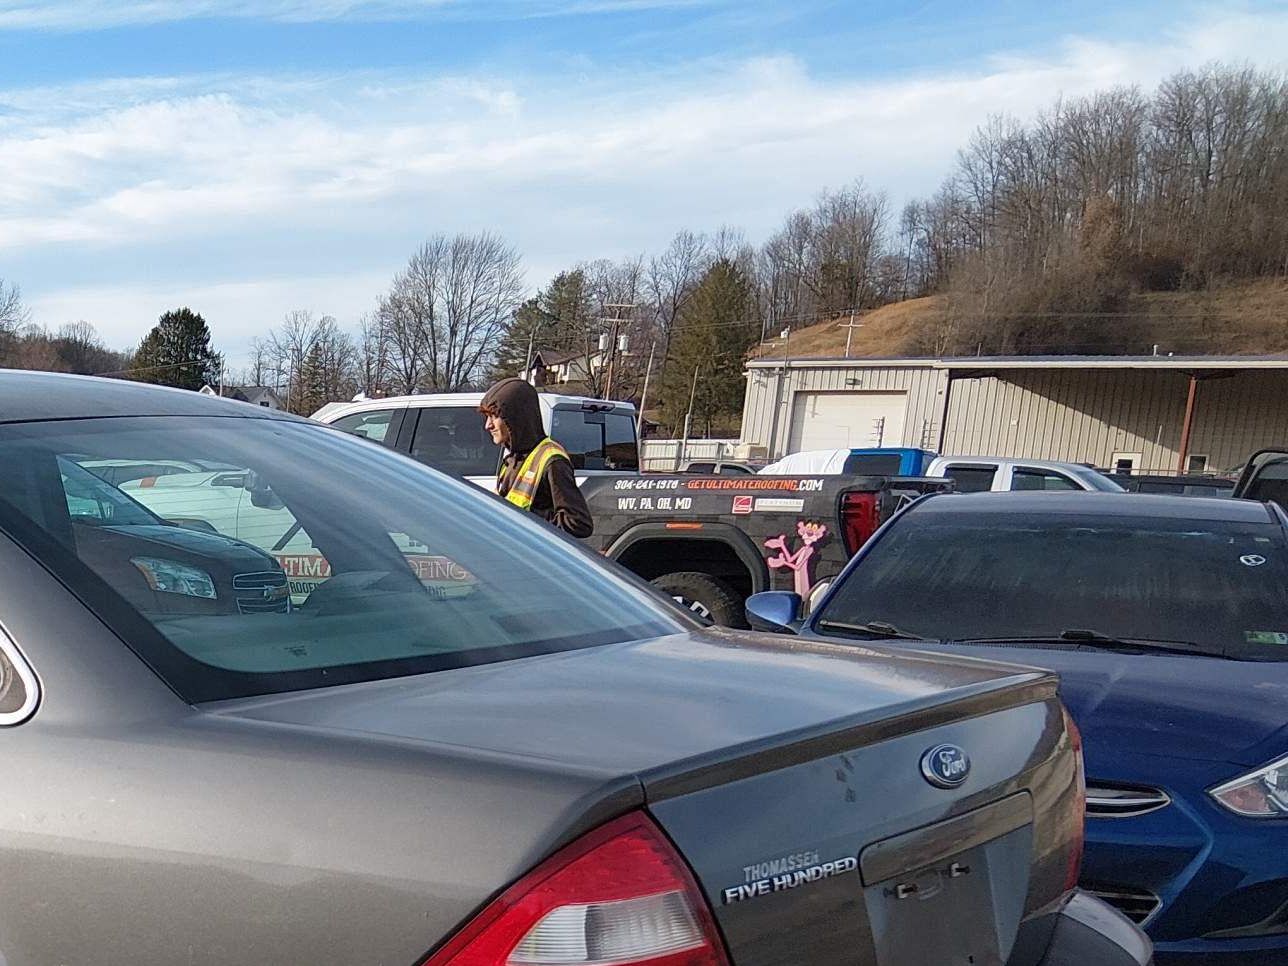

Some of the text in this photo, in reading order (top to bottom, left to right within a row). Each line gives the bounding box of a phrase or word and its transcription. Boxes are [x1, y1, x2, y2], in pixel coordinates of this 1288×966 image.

[687, 478, 824, 491] GETULTIMATEROOFING.COM
[674, 498, 692, 510] MD
[938, 749, 967, 777] Ford
[724, 856, 858, 905] FIVE HUNDRED
